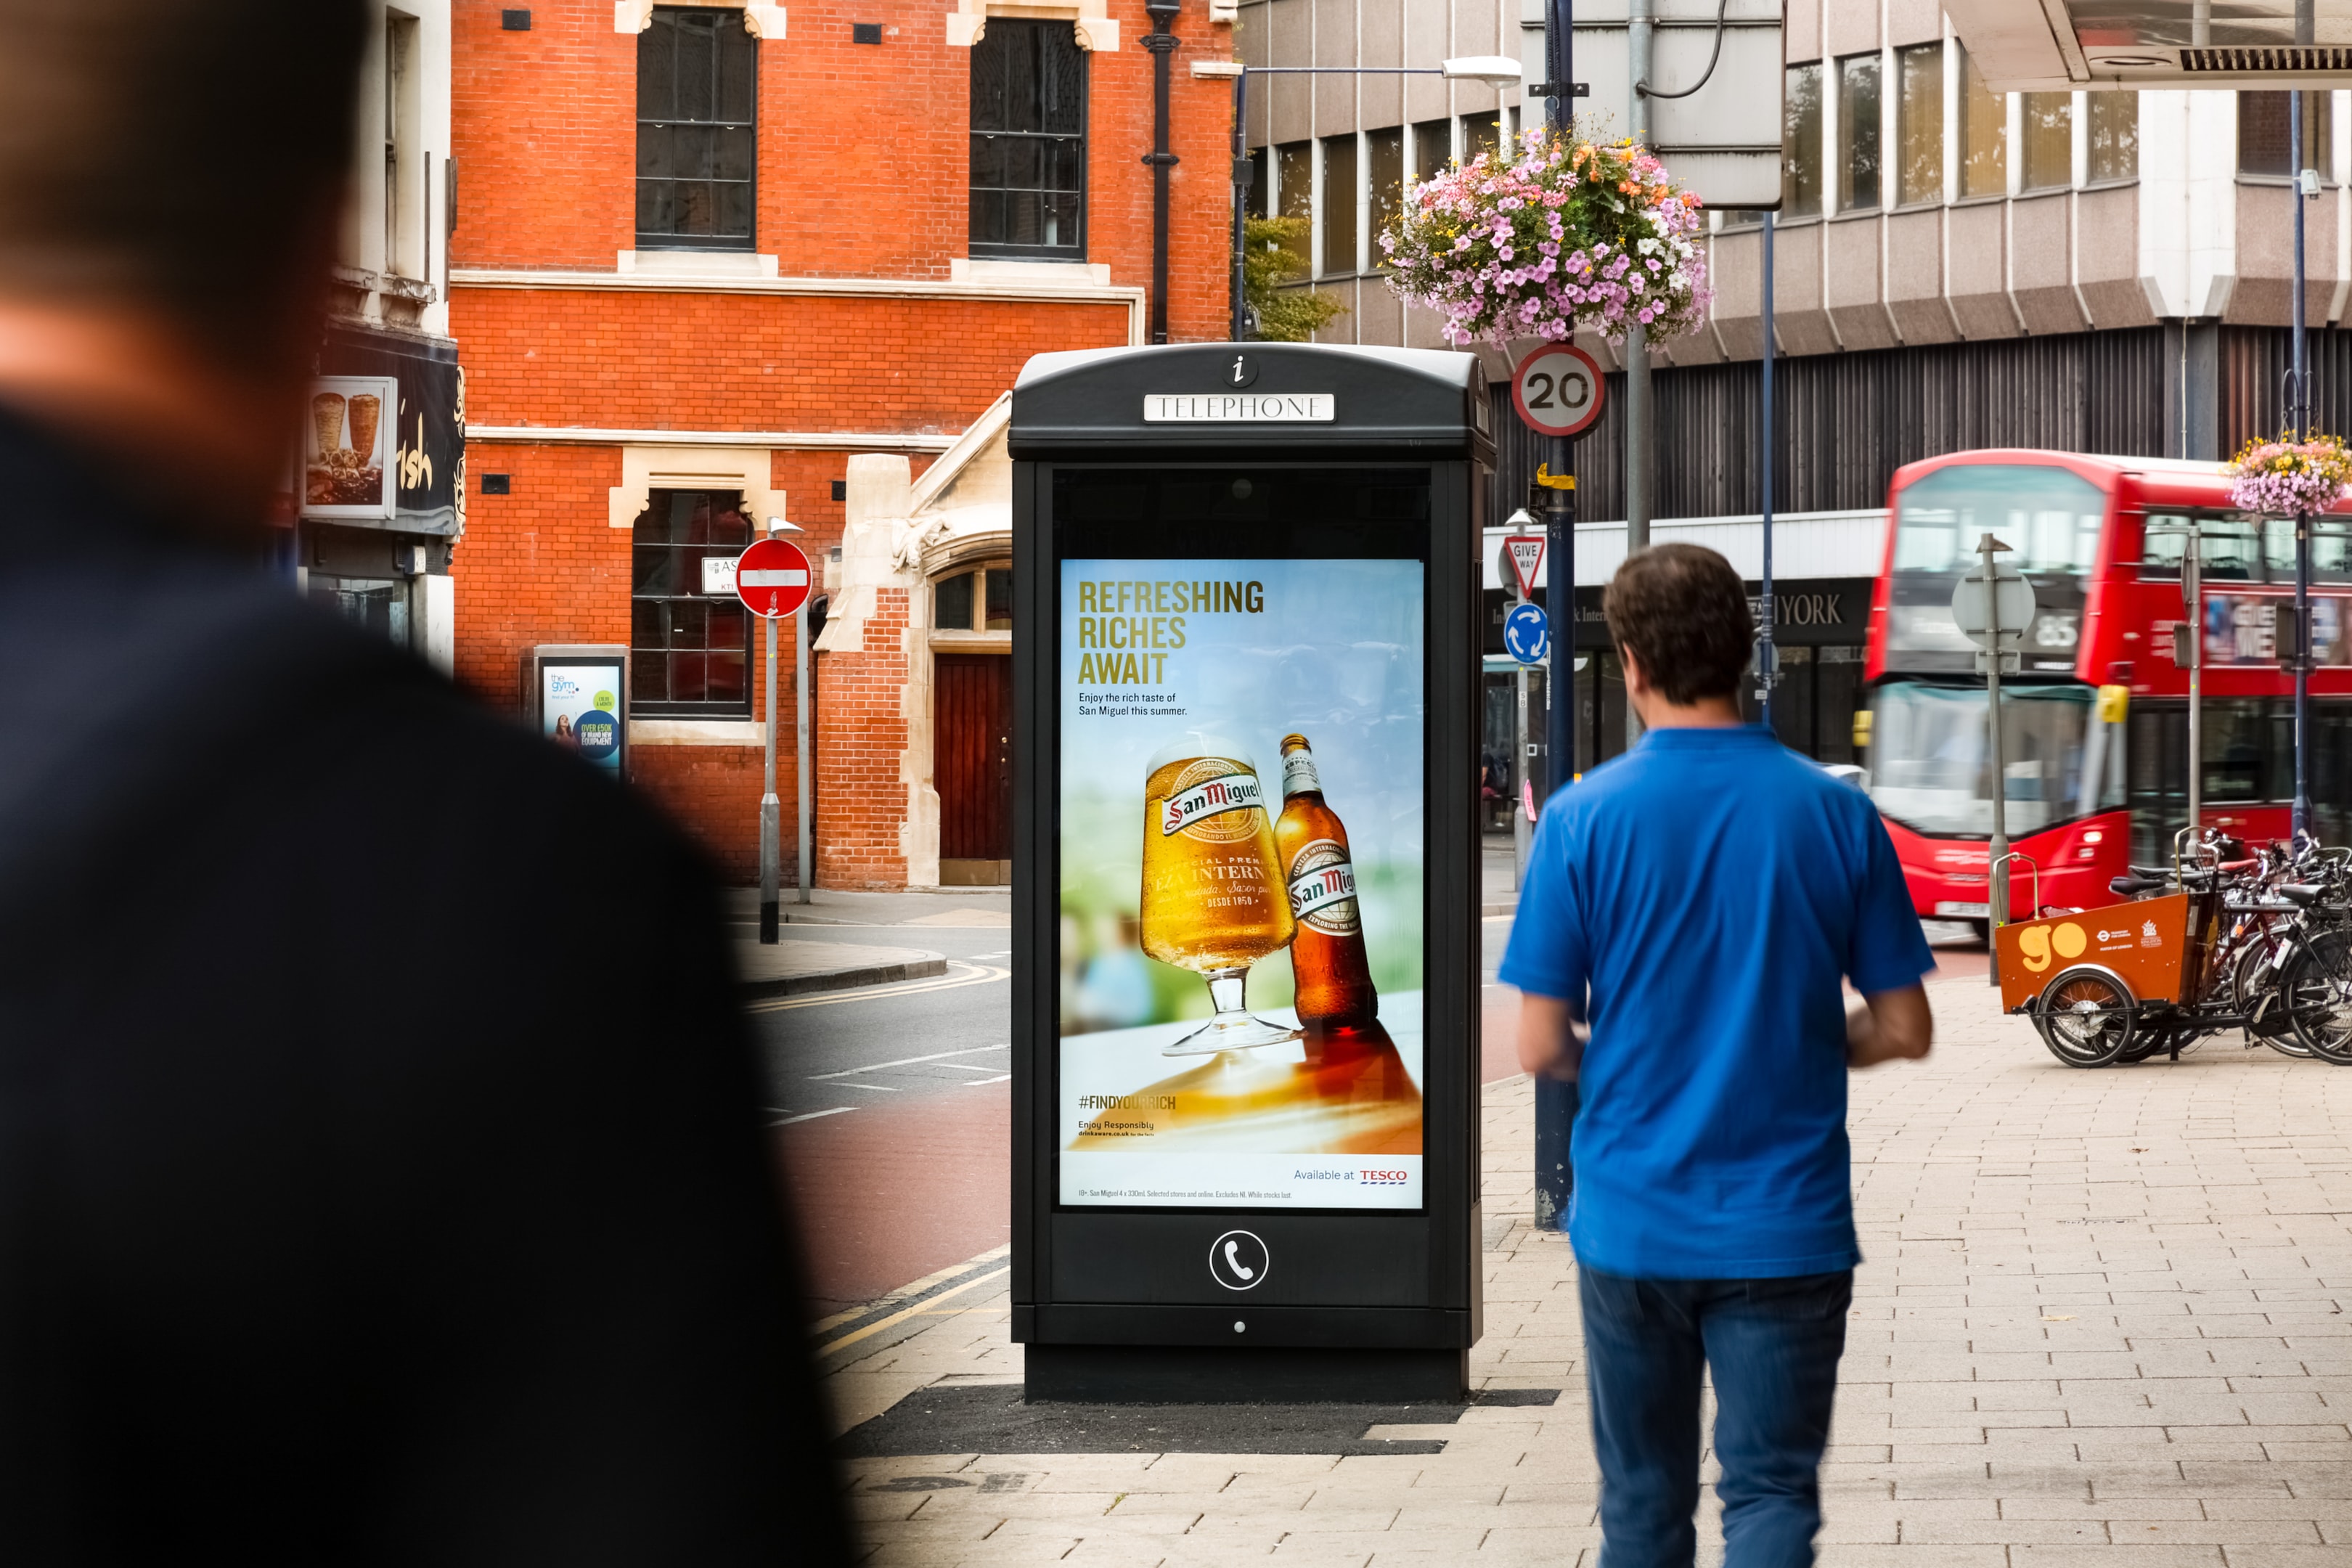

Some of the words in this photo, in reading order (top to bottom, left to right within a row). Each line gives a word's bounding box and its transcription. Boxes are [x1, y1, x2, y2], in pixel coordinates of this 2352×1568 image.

[1527, 372, 1589, 410] 20
[1156, 397, 1321, 417] TELEPHONE
[1514, 545, 1537, 557] GIVE
[1079, 581, 1264, 613] REFRESHING
[1079, 616, 1186, 649] RICHES
[2035, 616, 2078, 646] 85
[1078, 653, 1168, 685] AWAIT
[552, 682, 575, 692] gym
[1079, 693, 1103, 704] Enjoy
[1106, 693, 1119, 702] the
[1122, 693, 1139, 702] rich
[1167, 693, 1176, 702] of
[1079, 706, 1096, 716] San
[1099, 706, 1129, 717] Miguel
[1131, 706, 1148, 716] this
[581, 724, 595, 732] OVER
[1293, 853, 1310, 877] CERVEZA
[1208, 897, 1231, 907] DESDE
[1307, 915, 1339, 930] EXPLORING
[2019, 922, 2087, 973] go
[1079, 1095, 1176, 1109] #FINDYOURRICH
[1079, 1121, 1101, 1130] Enjoy
[1104, 1121, 1154, 1130] Responsibly
[1294, 1169, 1341, 1180] Available
[1344, 1171, 1355, 1180] at
[1360, 1170, 1408, 1180] TESCO
[1101, 1189, 1119, 1198] Miguel
